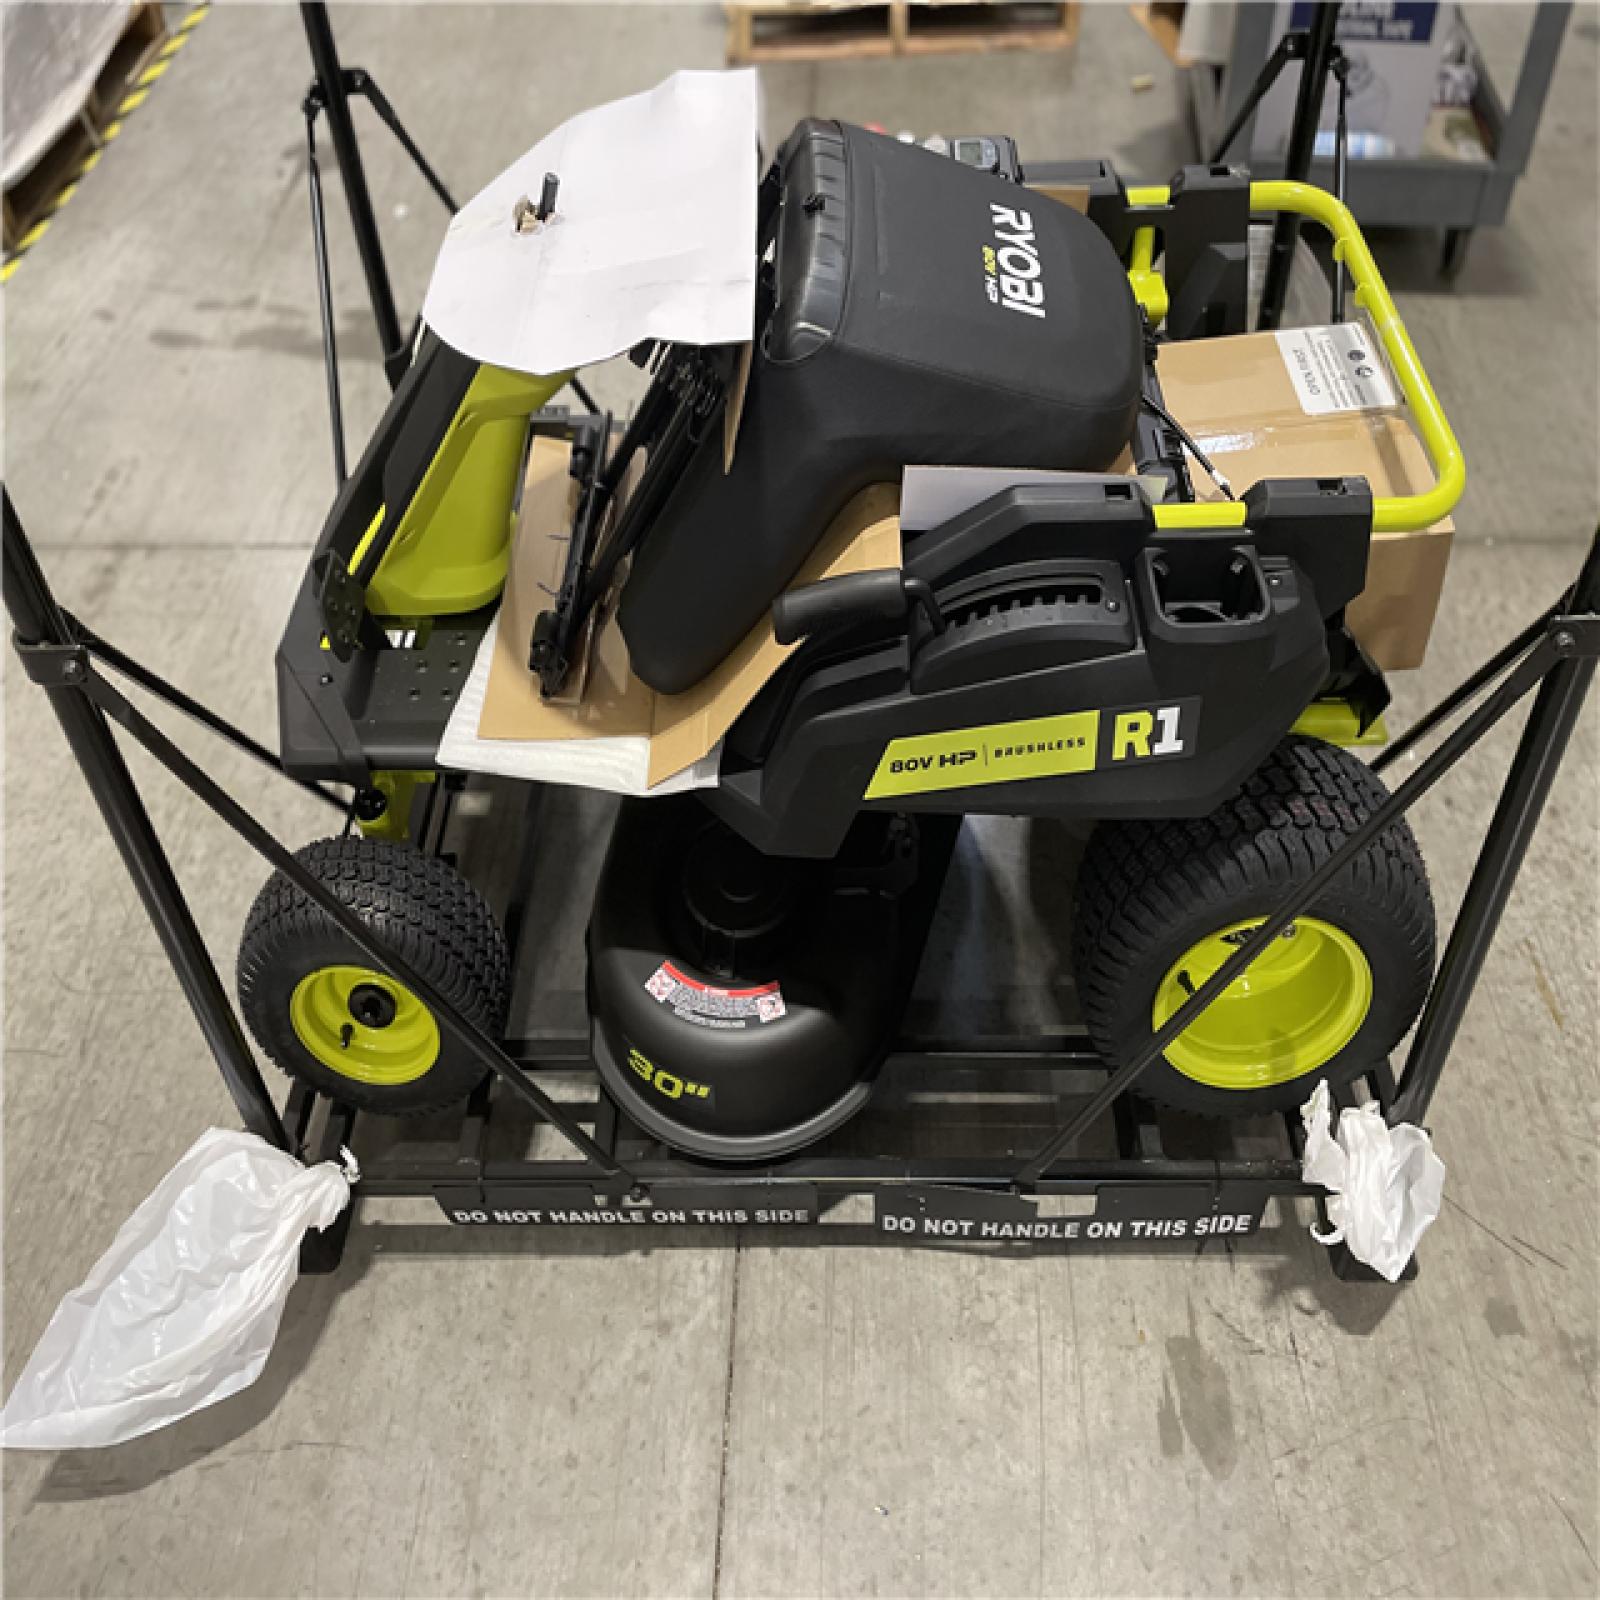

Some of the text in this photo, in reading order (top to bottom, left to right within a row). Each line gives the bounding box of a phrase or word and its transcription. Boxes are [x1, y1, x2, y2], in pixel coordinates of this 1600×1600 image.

[990, 202, 1046, 319] RYOBI
[1111, 706, 1184, 761] R1
[889, 736, 1086, 774] 80V HP BRUSHLESS
[454, 1209, 810, 1224] DO NOT HANDLE ON THIS SIDE
[882, 1214, 1253, 1239] DO NOT HANDLE ON THIS SIDE
